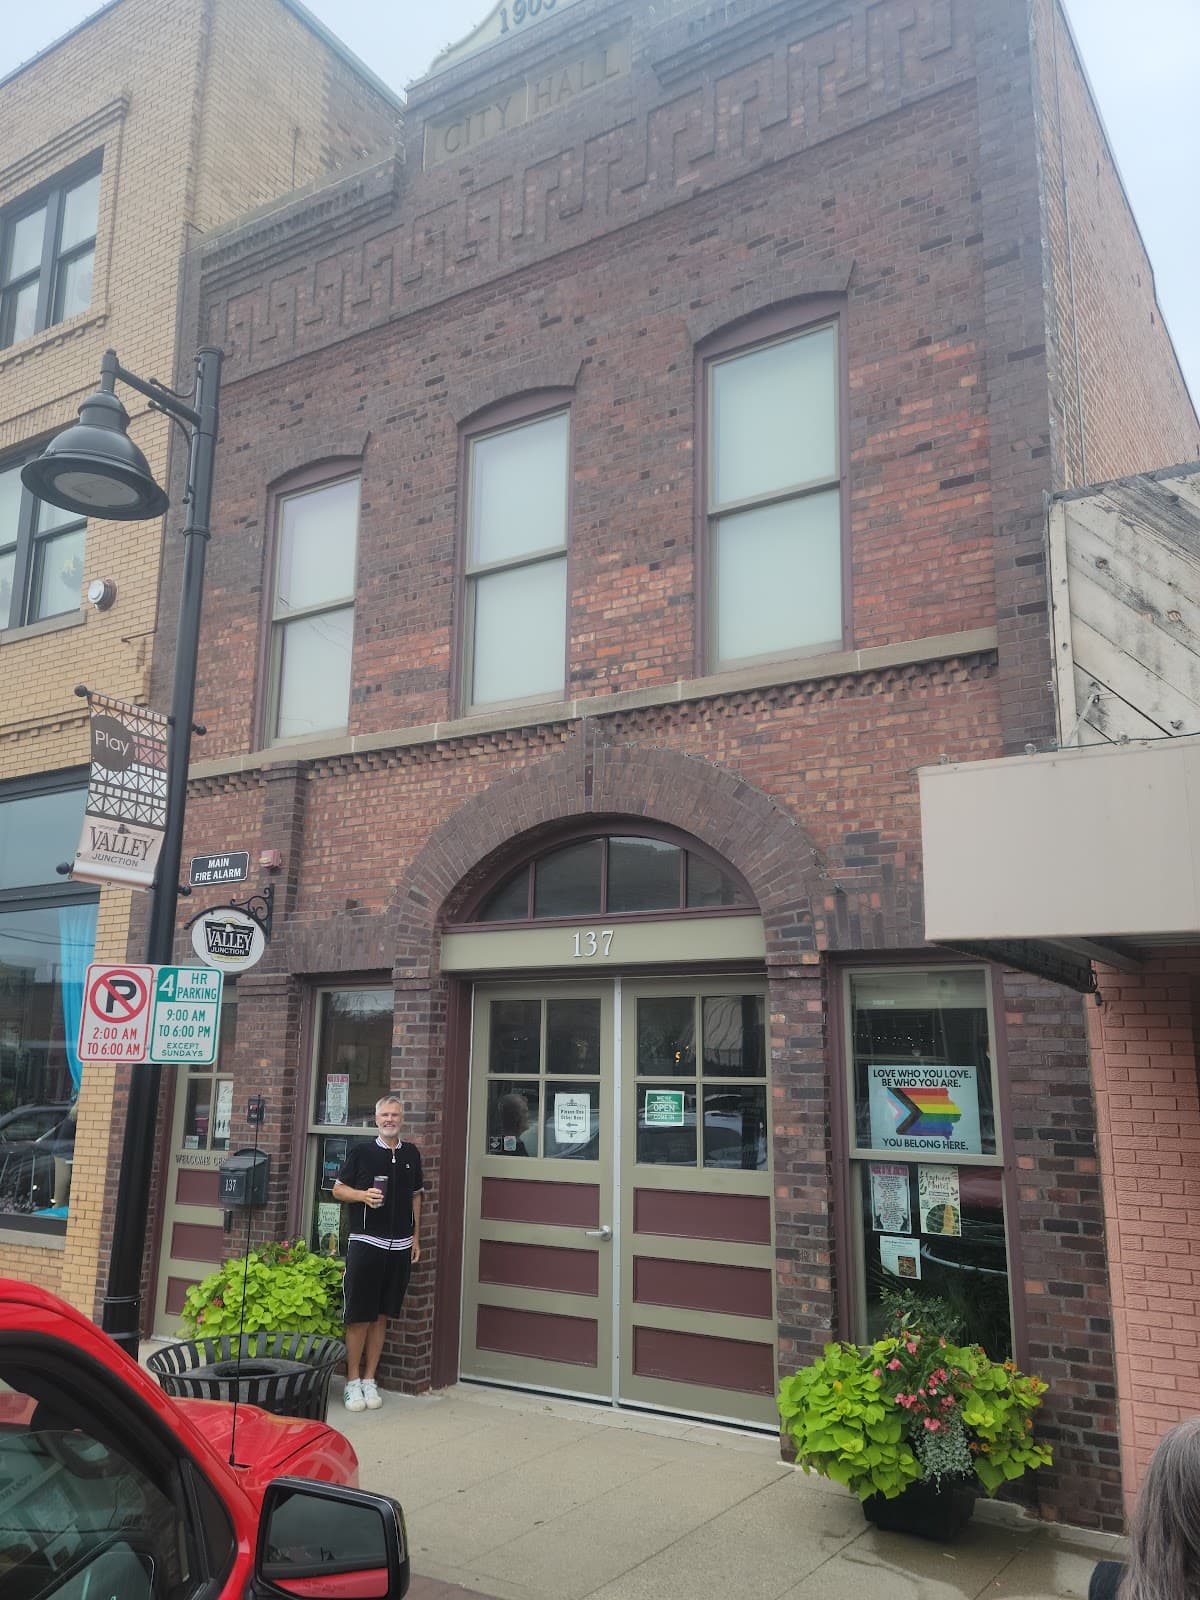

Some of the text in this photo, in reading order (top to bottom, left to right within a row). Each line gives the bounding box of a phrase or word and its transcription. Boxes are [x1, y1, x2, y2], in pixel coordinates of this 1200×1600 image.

[444, 50, 620, 153] CITY HALL
[95, 730, 130, 756] Play
[89, 825, 155, 861] VALLEY
[92, 853, 139, 867] JUNCTION
[208, 858, 230, 869] MAIN
[195, 868, 241, 882] FIRE ALARM
[205, 927, 253, 951] VALLEY
[572, 930, 615, 957] 137
[210, 946, 245, 955] JUNCTION
[192, 972, 208, 985] HR
[159, 974, 174, 997] 4
[177, 987, 217, 1000] PARKING
[166, 1008, 206, 1022] 9:00 AM
[93, 1027, 138, 1040] 2:00 AM
[159, 1024, 211, 1038] TO 6:00 PM
[88, 1042, 99, 1055] TO
[126, 1042, 140, 1056] AM
[166, 1042, 200, 1050] EXCEPT
[161, 1049, 204, 1057] SUNDAYS
[873, 1069, 972, 1079] LOVE WHO YOU LOVE.
[882, 1078, 961, 1088] BE WHO YOU ARE.
[653, 1103, 675, 1112] OPEN
[882, 1138, 969, 1150] YOU BELONG HERE.
[175, 1154, 211, 1166] WELCOME
[225, 1179, 237, 1192] 137
